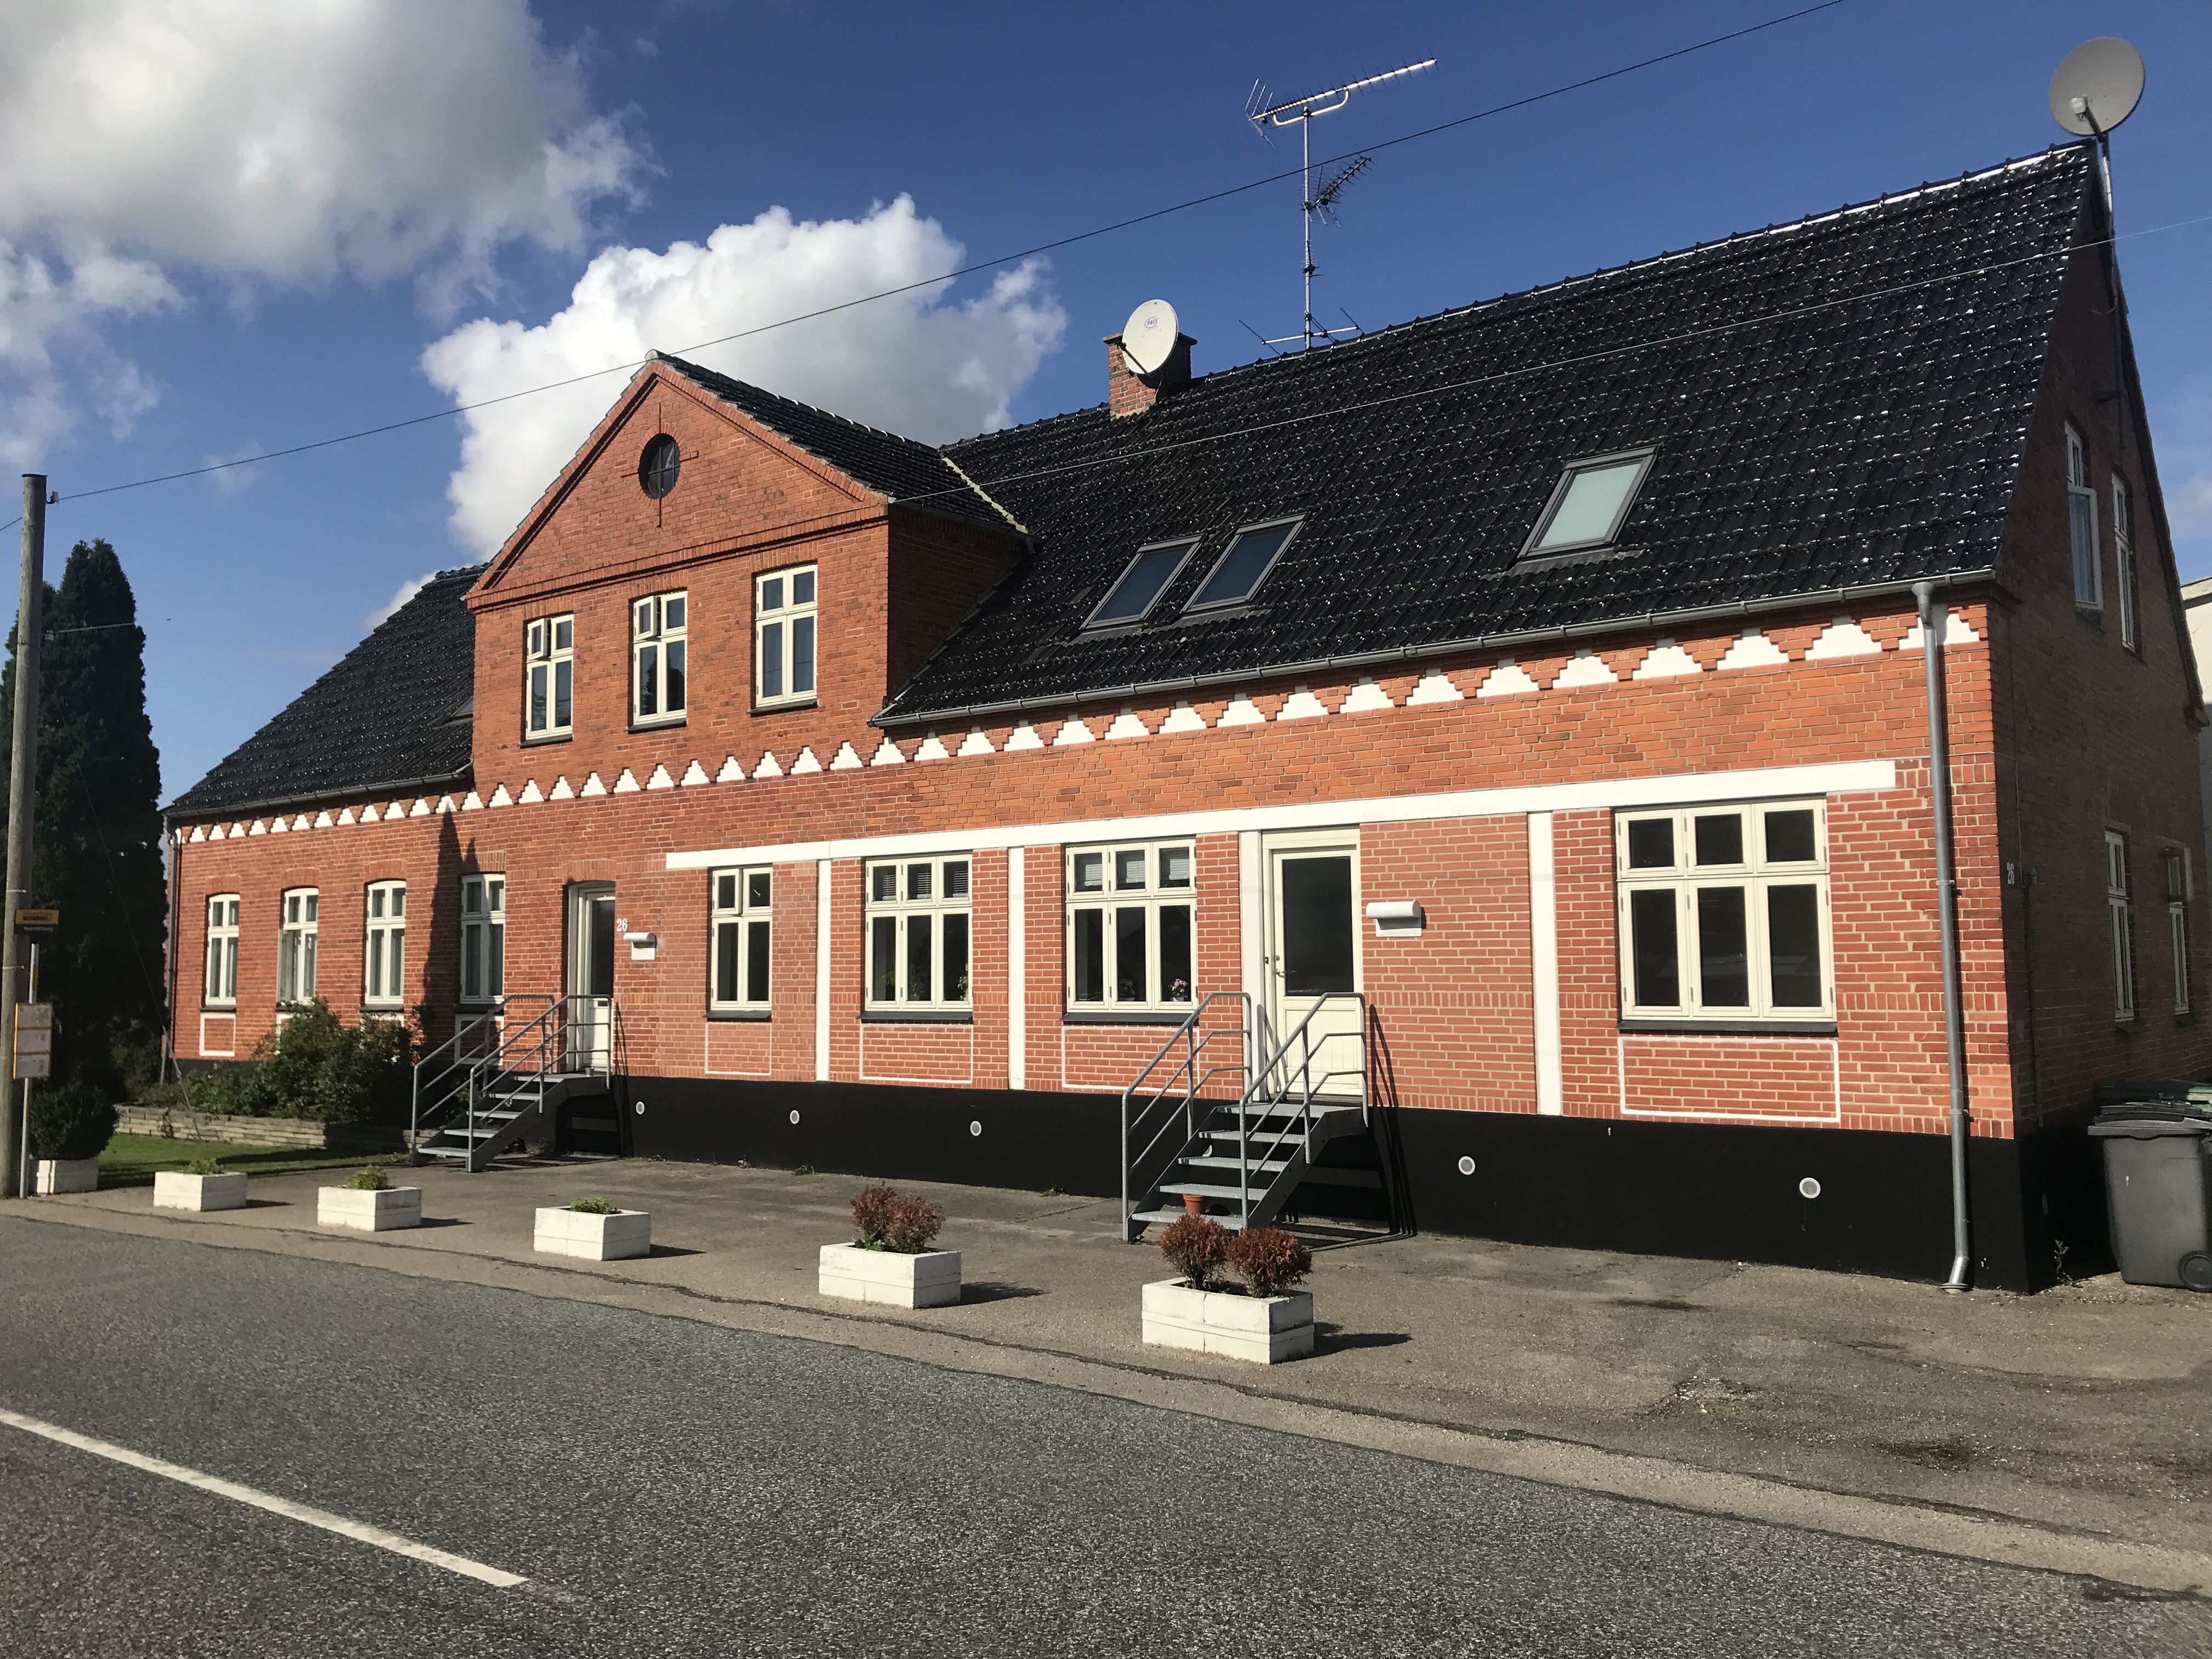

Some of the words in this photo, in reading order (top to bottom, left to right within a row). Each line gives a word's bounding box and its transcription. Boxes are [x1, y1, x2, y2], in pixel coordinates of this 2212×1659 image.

[1147, 318, 1159, 326] PACE
[2006, 862, 2015, 884] 26
[616, 918, 628, 932] 26
